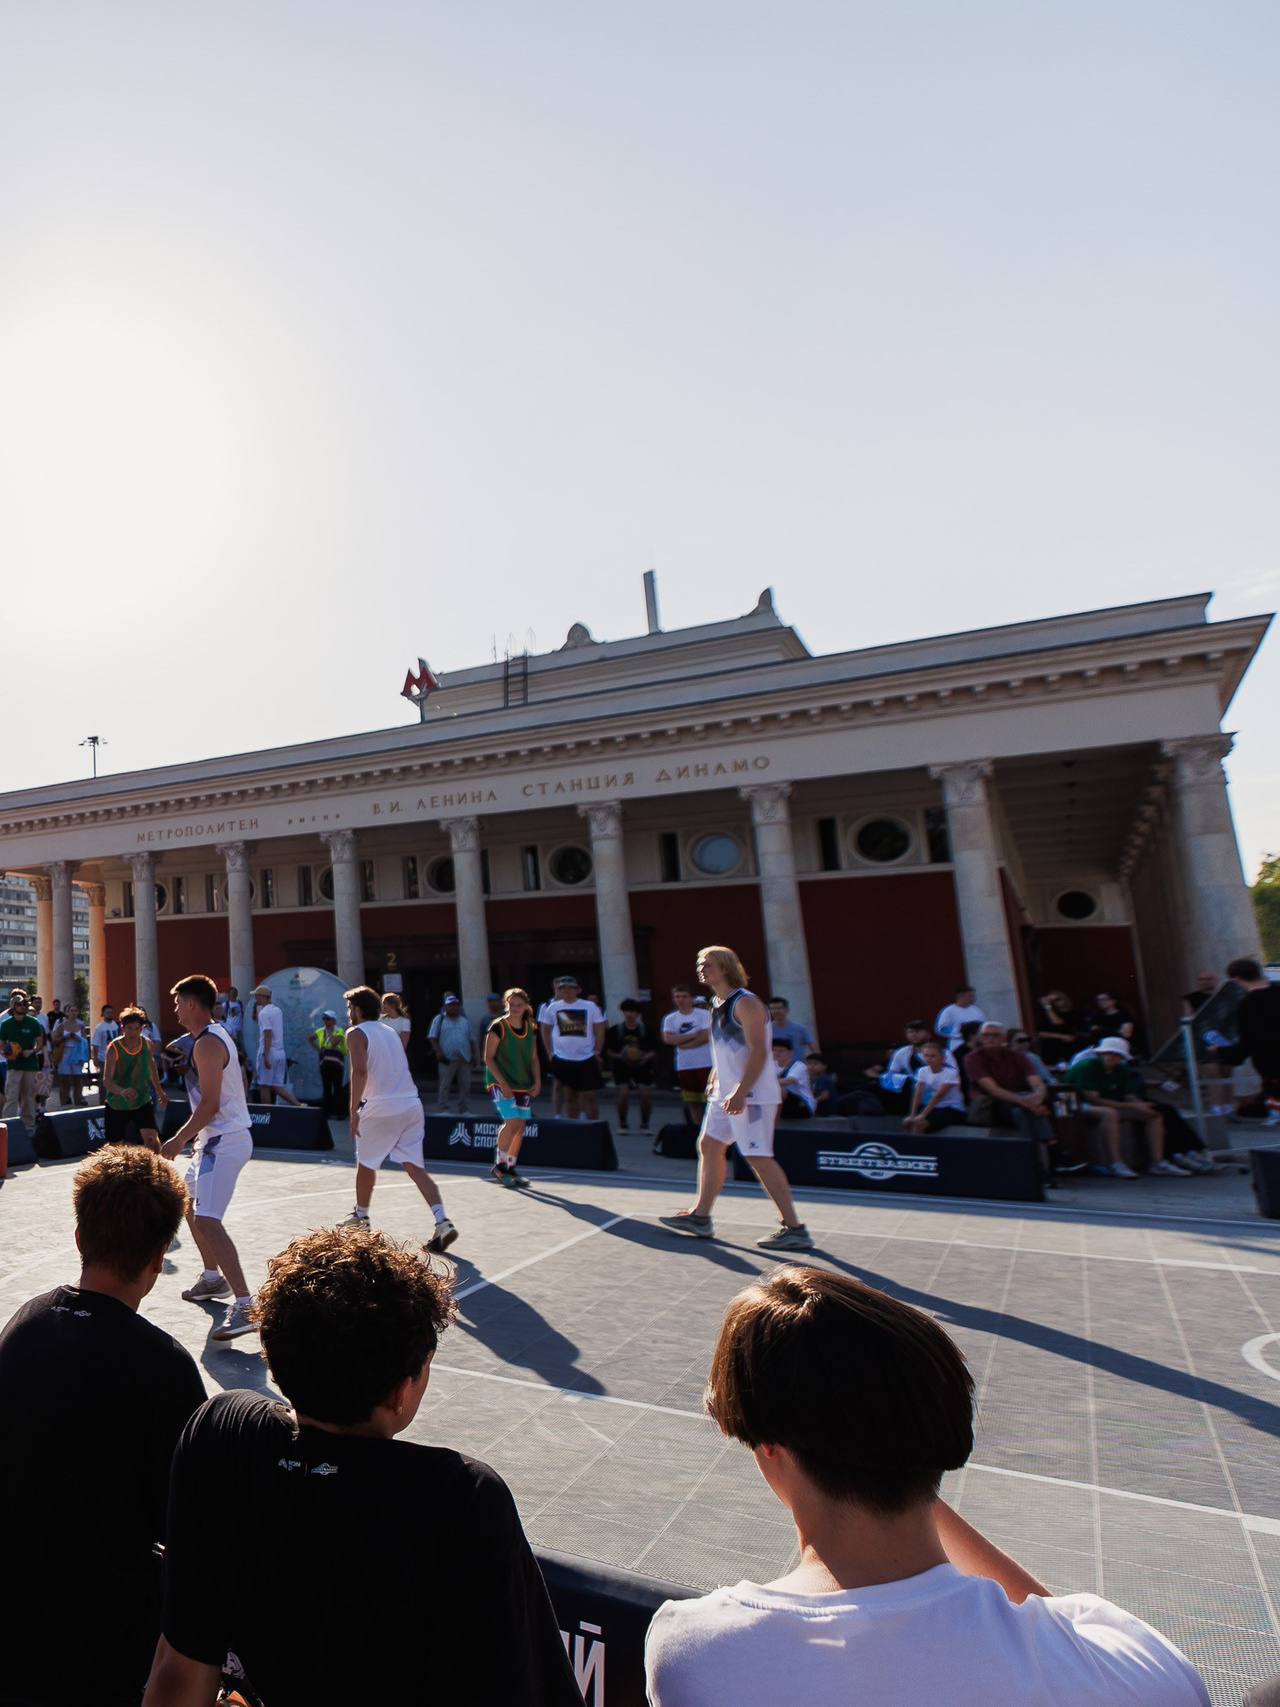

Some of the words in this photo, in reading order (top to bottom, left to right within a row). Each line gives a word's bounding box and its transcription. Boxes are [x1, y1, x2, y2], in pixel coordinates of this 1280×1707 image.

[136, 818, 260, 843] МЕТРОПОЛИТЕН
[417, 790, 497, 811] ЛЕНИНА
[522, 772, 635, 796] СТАНЦИЯ
[655, 756, 770, 782] ДИНАМО
[386, 952, 397, 967] 2
[474, 1135, 499, 1148] СПОР
[819, 1156, 938, 1171] STREETBASKET
